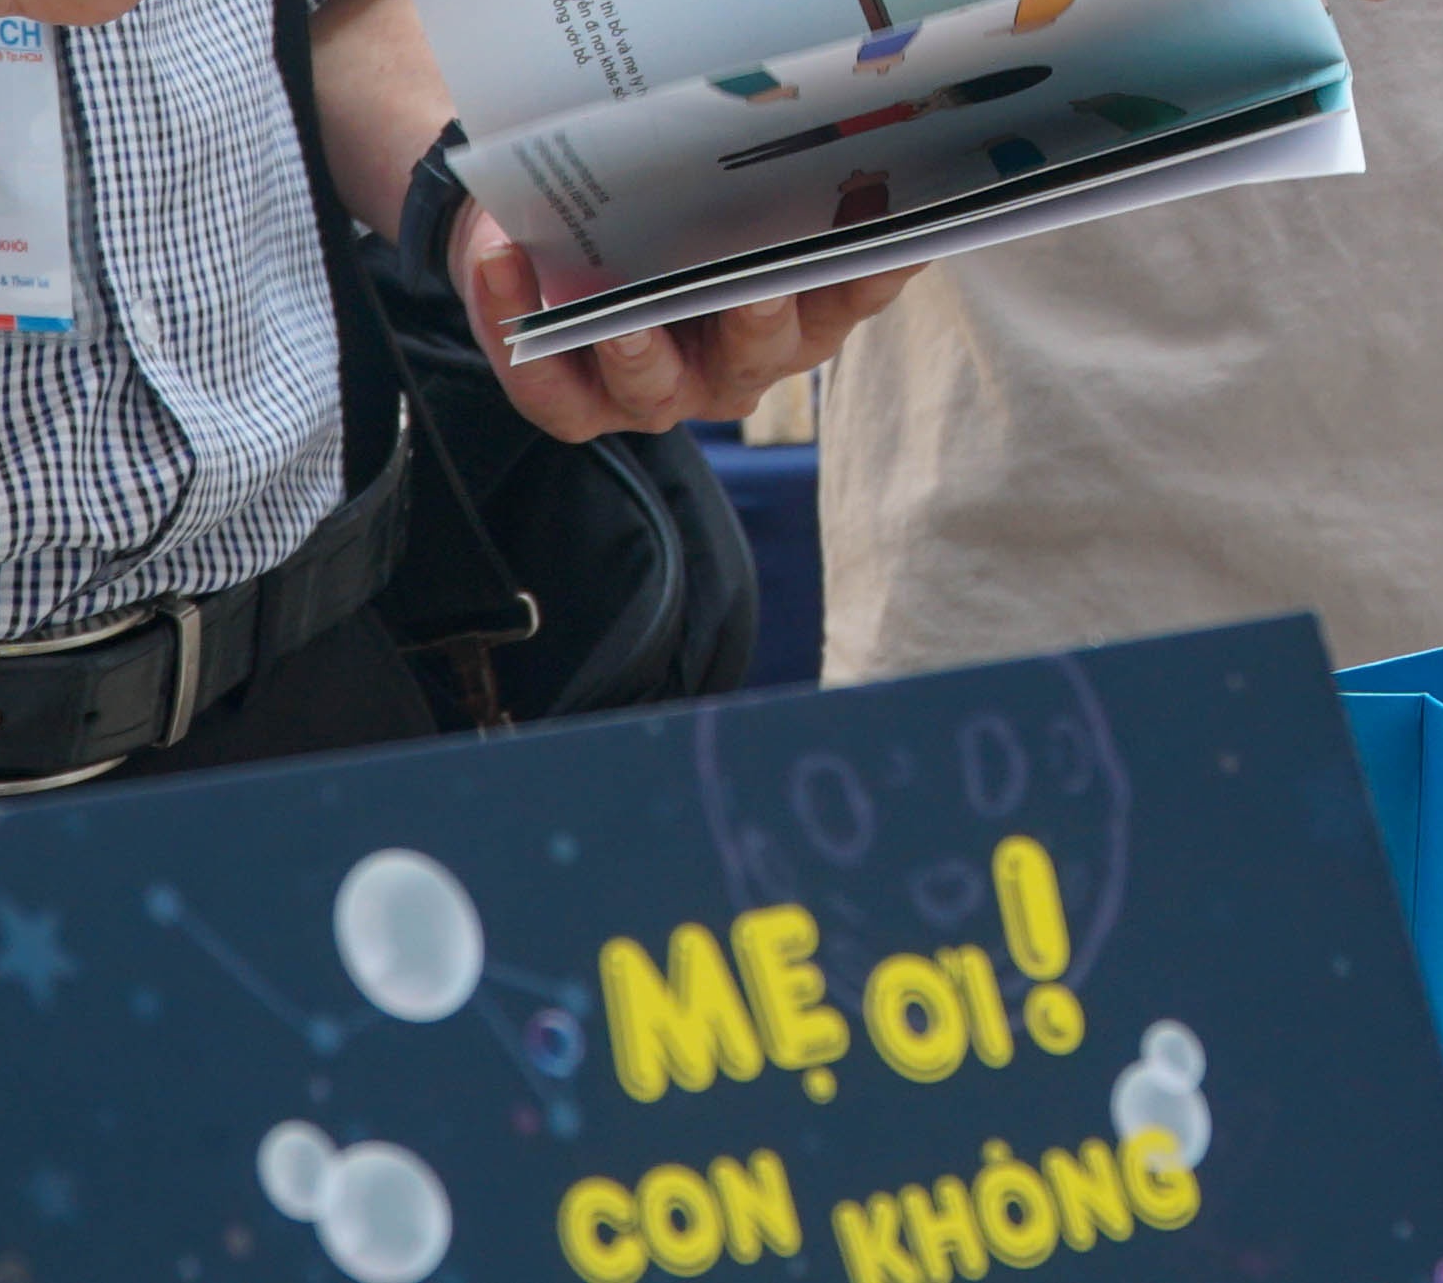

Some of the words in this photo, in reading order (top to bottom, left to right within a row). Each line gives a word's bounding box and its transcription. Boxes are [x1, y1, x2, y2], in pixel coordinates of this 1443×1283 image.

[600, 0, 619, 19] thì
[565, 25, 583, 47] với
[608, 18, 629, 37] bố
[590, 34, 610, 55] nơi
[617, 38, 633, 55] và
[599, 55, 620, 86] khác
[622, 56, 638, 75] mẹ
[598, 902, 851, 1104] MẸ
[558, 1147, 803, 1283] CON
[830, 1123, 1201, 1283] KHÔNG
